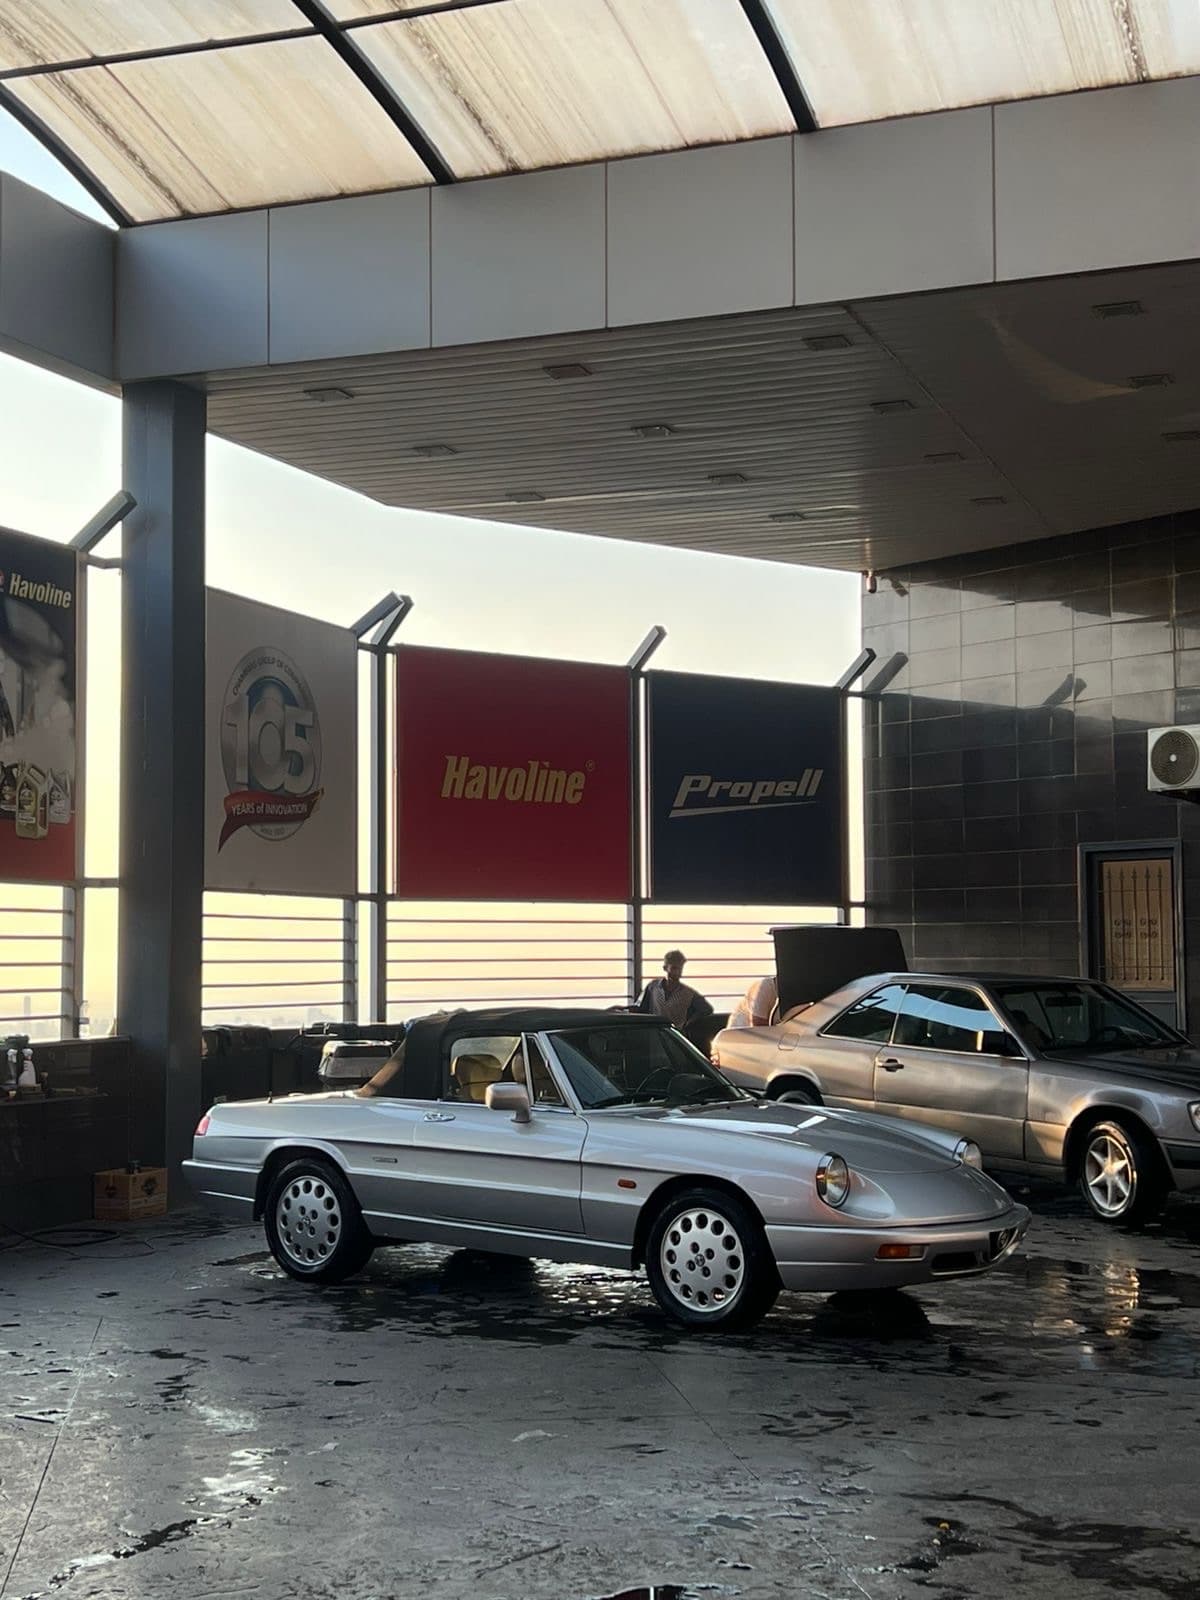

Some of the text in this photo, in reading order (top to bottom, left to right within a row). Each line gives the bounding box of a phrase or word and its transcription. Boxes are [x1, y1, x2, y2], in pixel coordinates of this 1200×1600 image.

[9, 573, 72, 608] Havoline
[225, 697, 315, 794] 105
[440, 755, 587, 804] Havoline
[672, 768, 824, 808] Propell
[231, 801, 308, 816] YEARS of INNOVATION
